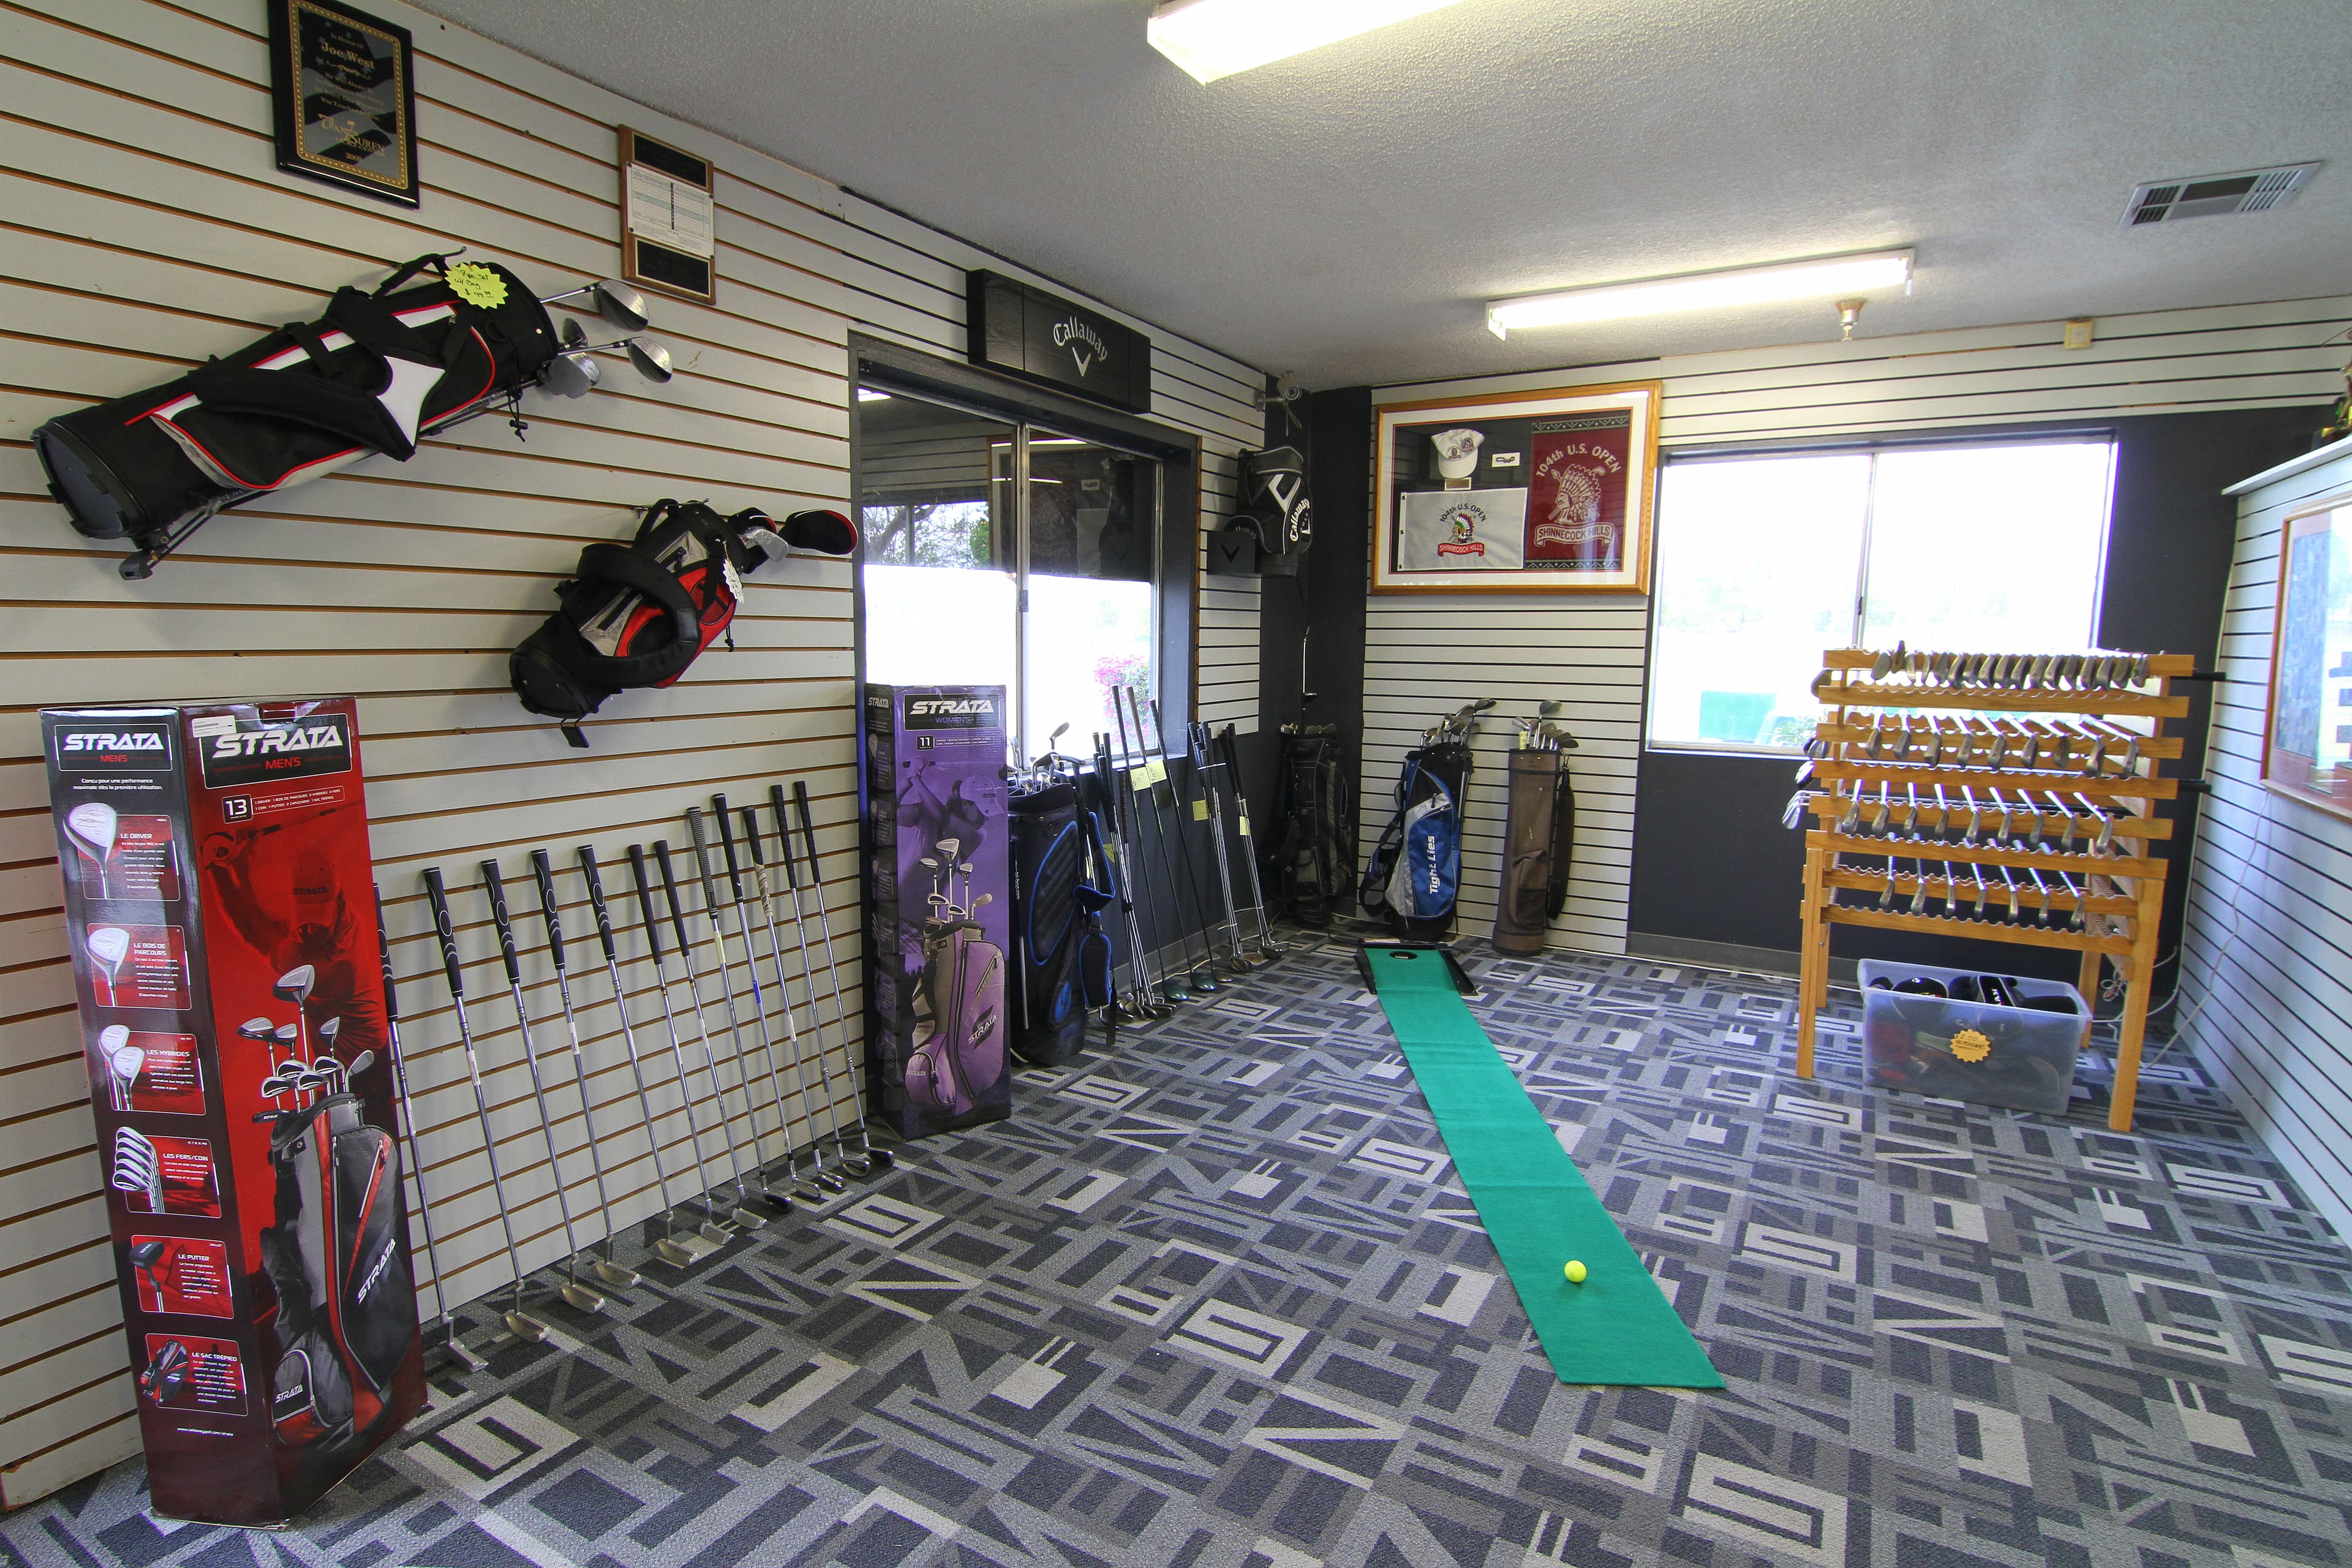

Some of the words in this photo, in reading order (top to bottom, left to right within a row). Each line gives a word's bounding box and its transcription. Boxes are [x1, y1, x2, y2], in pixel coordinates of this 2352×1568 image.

[321, 42, 344, 58] Joe
[346, 50, 375, 69] West
[1053, 315, 1107, 362] Callaway
[1536, 449, 1564, 477] 104th
[1567, 443, 1588, 455] U.S.
[1592, 446, 1622, 473] OPEN
[1289, 498, 1310, 542] Callaway
[1440, 507, 1457, 522] 104th
[1471, 505, 1487, 522] OPEN
[1539, 528, 1586, 540] SHINNECOCK
[1588, 526, 1610, 537] HILLS
[1439, 545, 1469, 553] SHINNECOCK
[869, 696, 889, 708] STRATA
[909, 699, 995, 715] STRATA
[63, 733, 164, 750] STRATA
[212, 725, 344, 758] STRATA
[920, 737, 930, 746] 11
[265, 756, 301, 770] MEN'S
[225, 799, 247, 816] 13
[1427, 835, 1436, 861] Lies
[1429, 863, 1440, 894] Tight
[968, 1014, 997, 1045] STRATA
[357, 1238, 396, 1305] STRATA
[276, 1384, 303, 1404] STRATA
